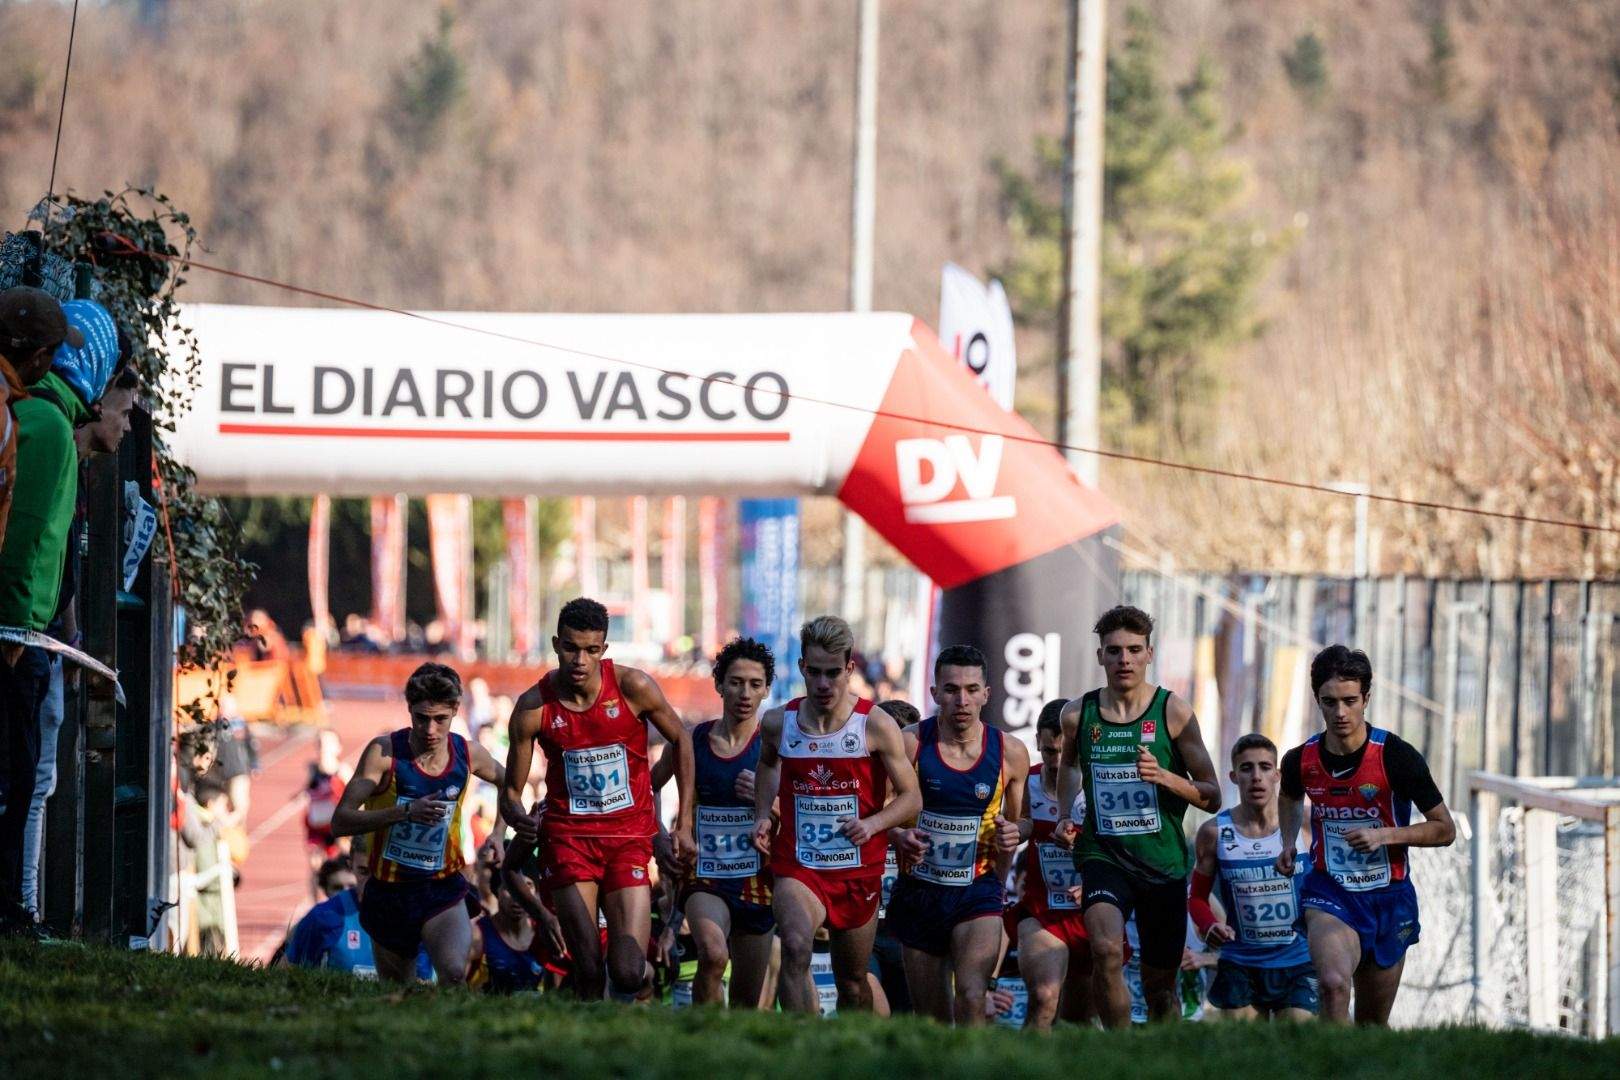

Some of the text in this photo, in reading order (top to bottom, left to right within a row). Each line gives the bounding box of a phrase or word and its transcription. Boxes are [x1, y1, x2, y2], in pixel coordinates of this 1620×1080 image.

[220, 363, 790, 421] EL DIARIO VASCO
[894, 434, 1004, 504] DV
[565, 748, 622, 764] kutxabank
[1091, 745, 1137, 753] VILLARREAL
[573, 769, 621, 792] 301
[589, 793, 627, 808] DANOBAT
[800, 801, 854, 812] kutxabank
[1100, 790, 1150, 810] 319
[701, 811, 753, 823] kutxabank
[1115, 818, 1156, 828] DANOBAT
[921, 818, 976, 832] kutxabank
[396, 822, 444, 847] 374
[703, 833, 753, 853] 316
[815, 852, 856, 863] DANOBAT
[716, 861, 757, 871] DANOBAT
[930, 868, 970, 879] DANOBAT
[1345, 873, 1386, 884] DANOBAT
[1236, 882, 1291, 894] kutxabank
[1243, 902, 1291, 922] 320
